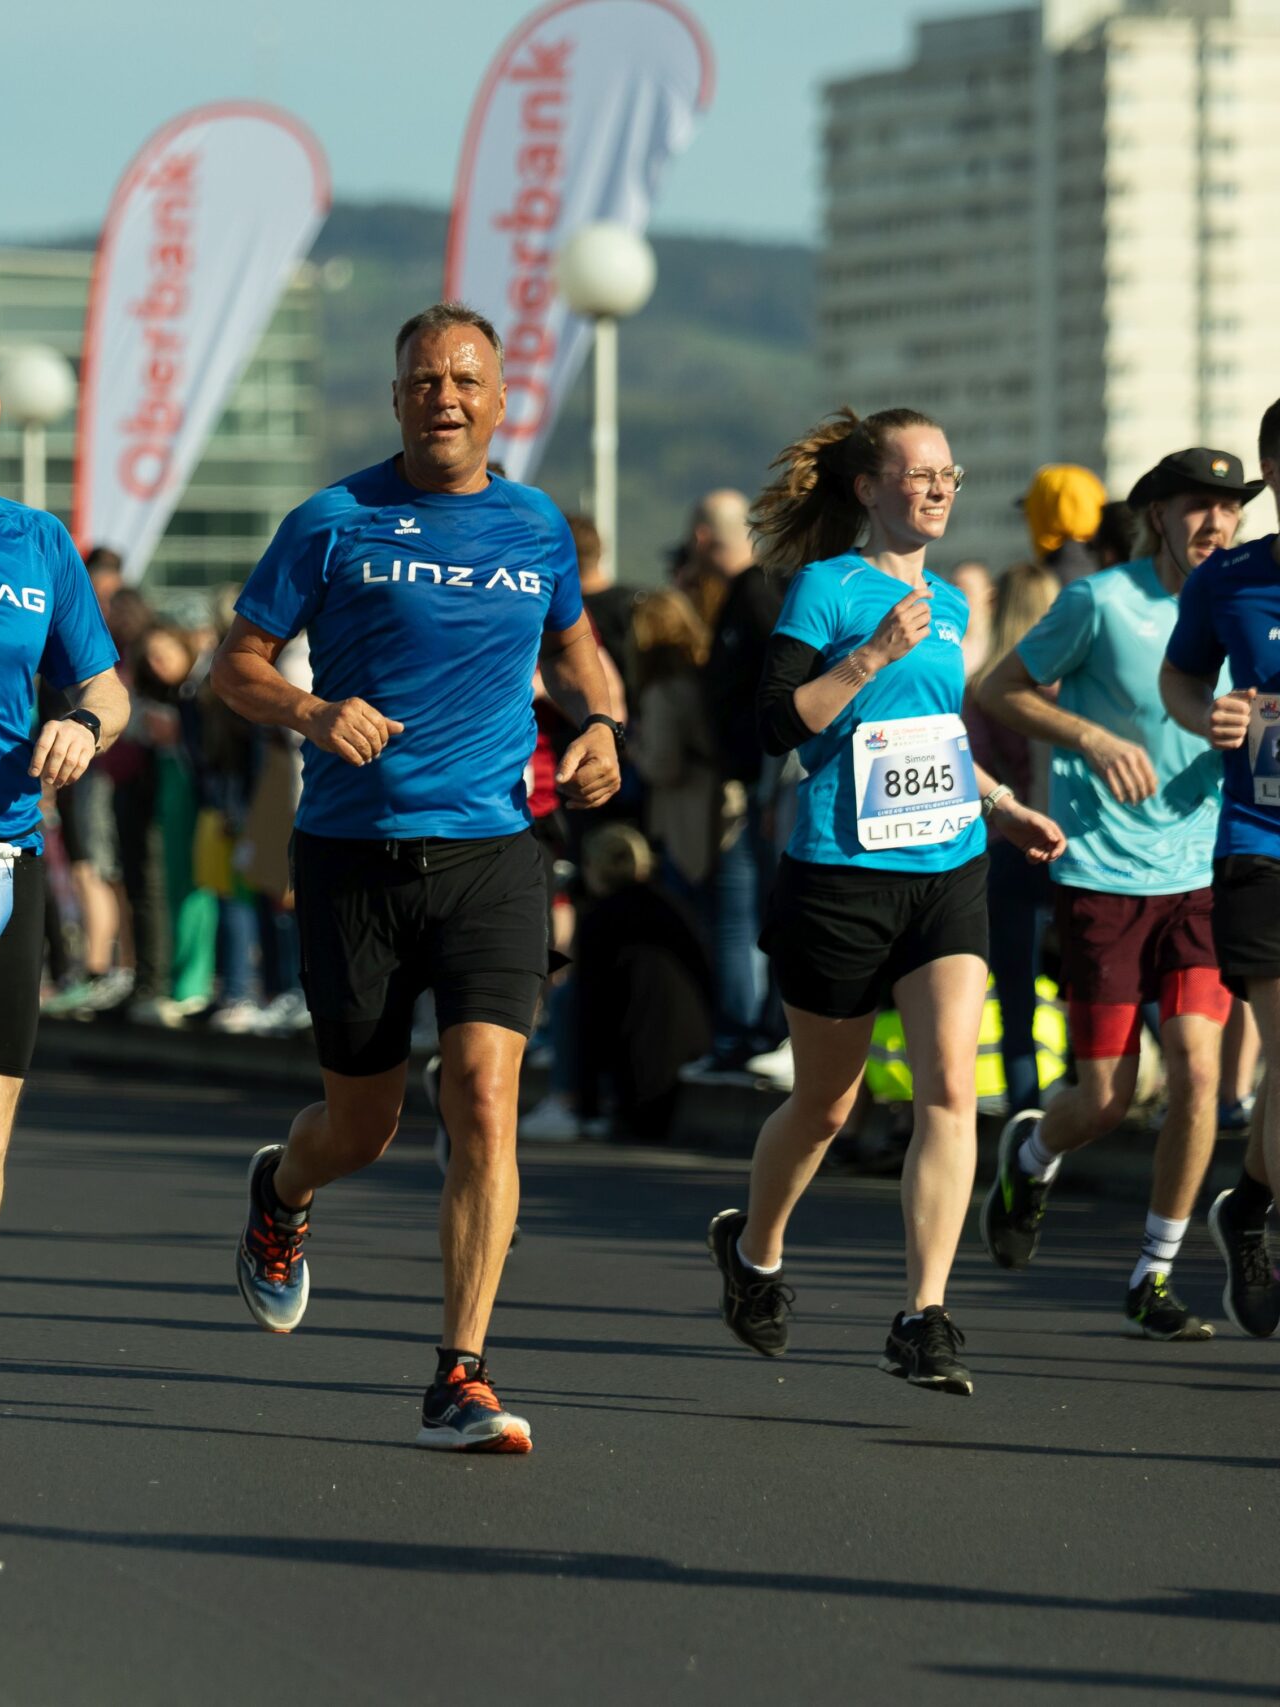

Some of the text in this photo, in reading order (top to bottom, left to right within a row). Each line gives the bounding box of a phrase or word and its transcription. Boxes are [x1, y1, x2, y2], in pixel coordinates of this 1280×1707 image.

[494, 37, 578, 439] Oberbank
[118, 148, 202, 501] Oberbank
[394, 527, 421, 535] erima
[363, 560, 541, 594] LINZ AG
[904, 754, 936, 765] Simone
[884, 764, 954, 798] 8845
[868, 820, 933, 841] LINZ
